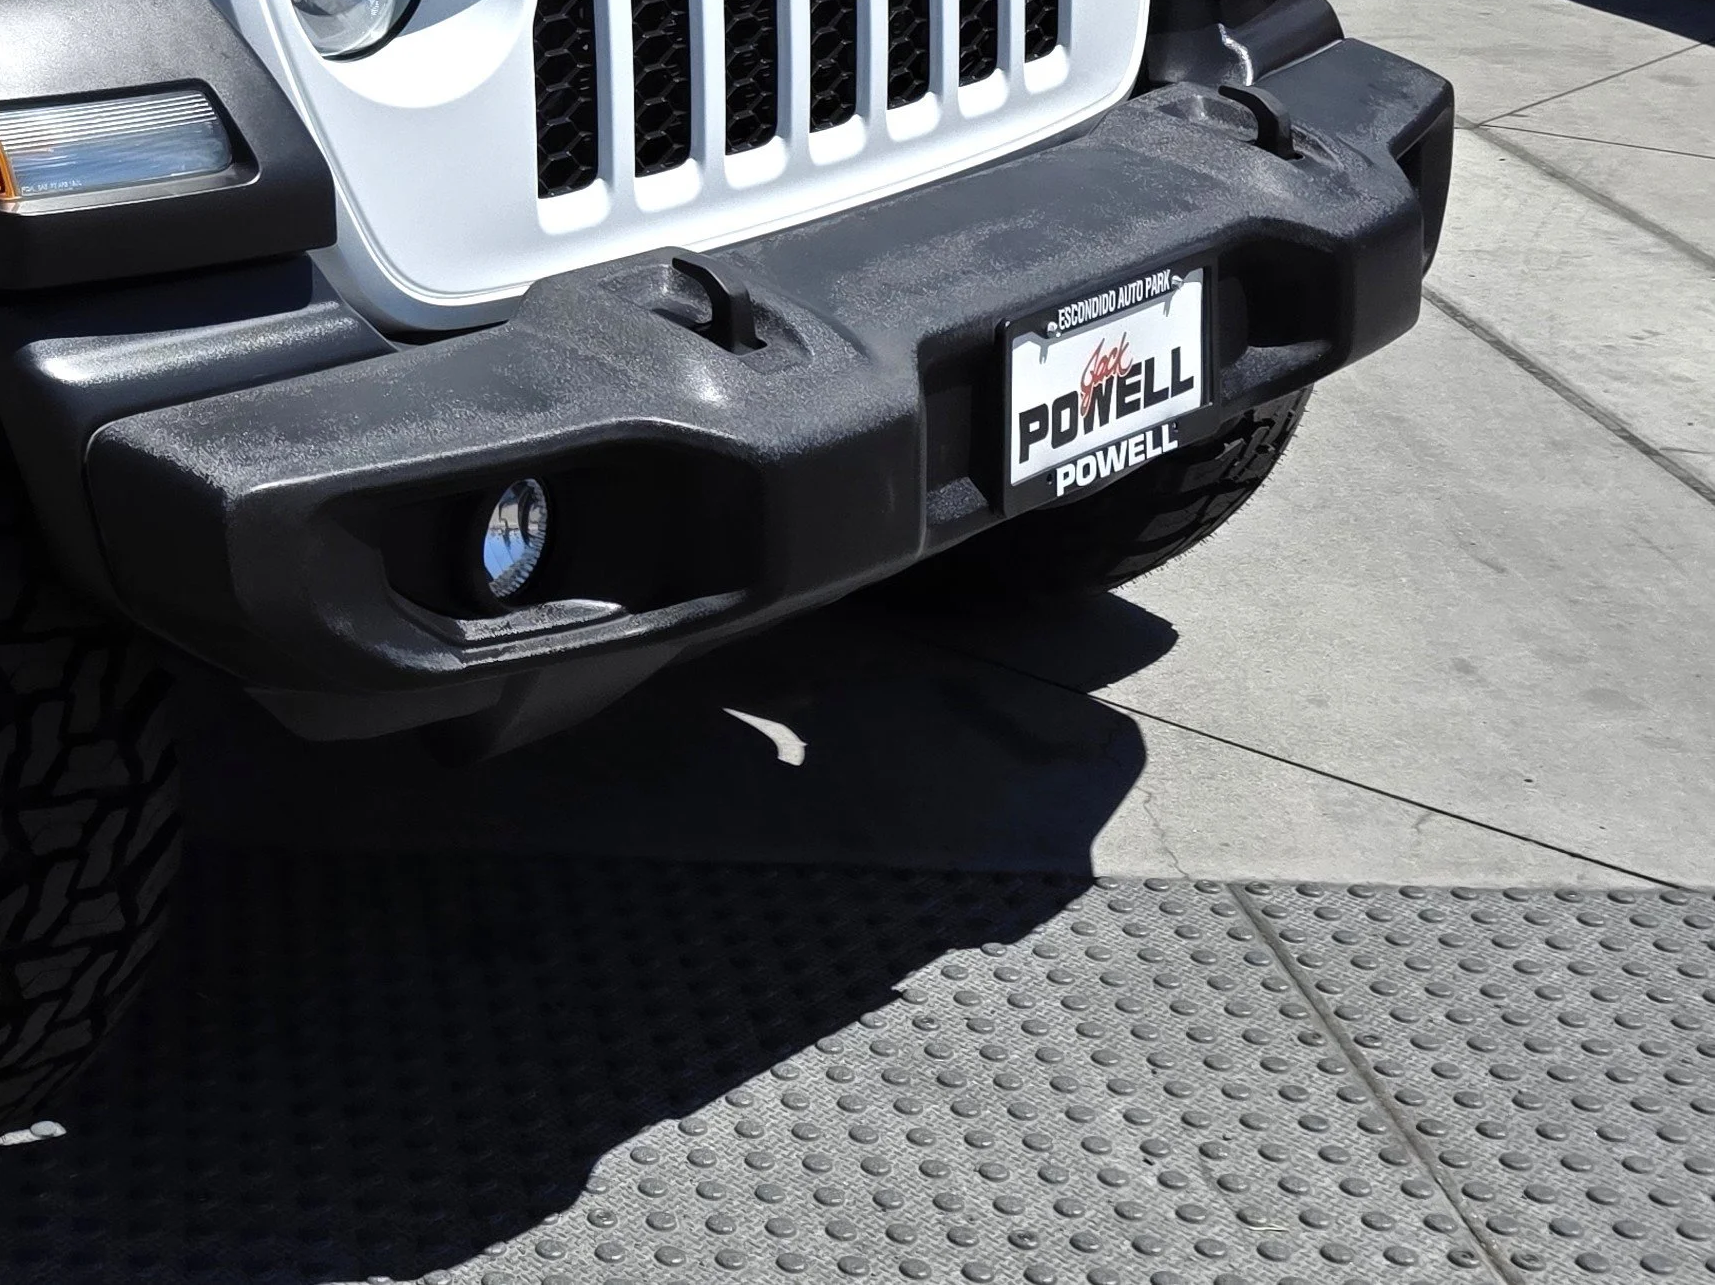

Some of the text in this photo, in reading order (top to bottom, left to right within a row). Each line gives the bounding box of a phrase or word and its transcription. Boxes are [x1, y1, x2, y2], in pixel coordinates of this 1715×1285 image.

[1058, 269, 1171, 330] ESCONDIDO AUTO PARK
[1019, 346, 1194, 464] POWELL
[1080, 332, 1133, 416] Jack
[1057, 424, 1179, 496] POWELL
